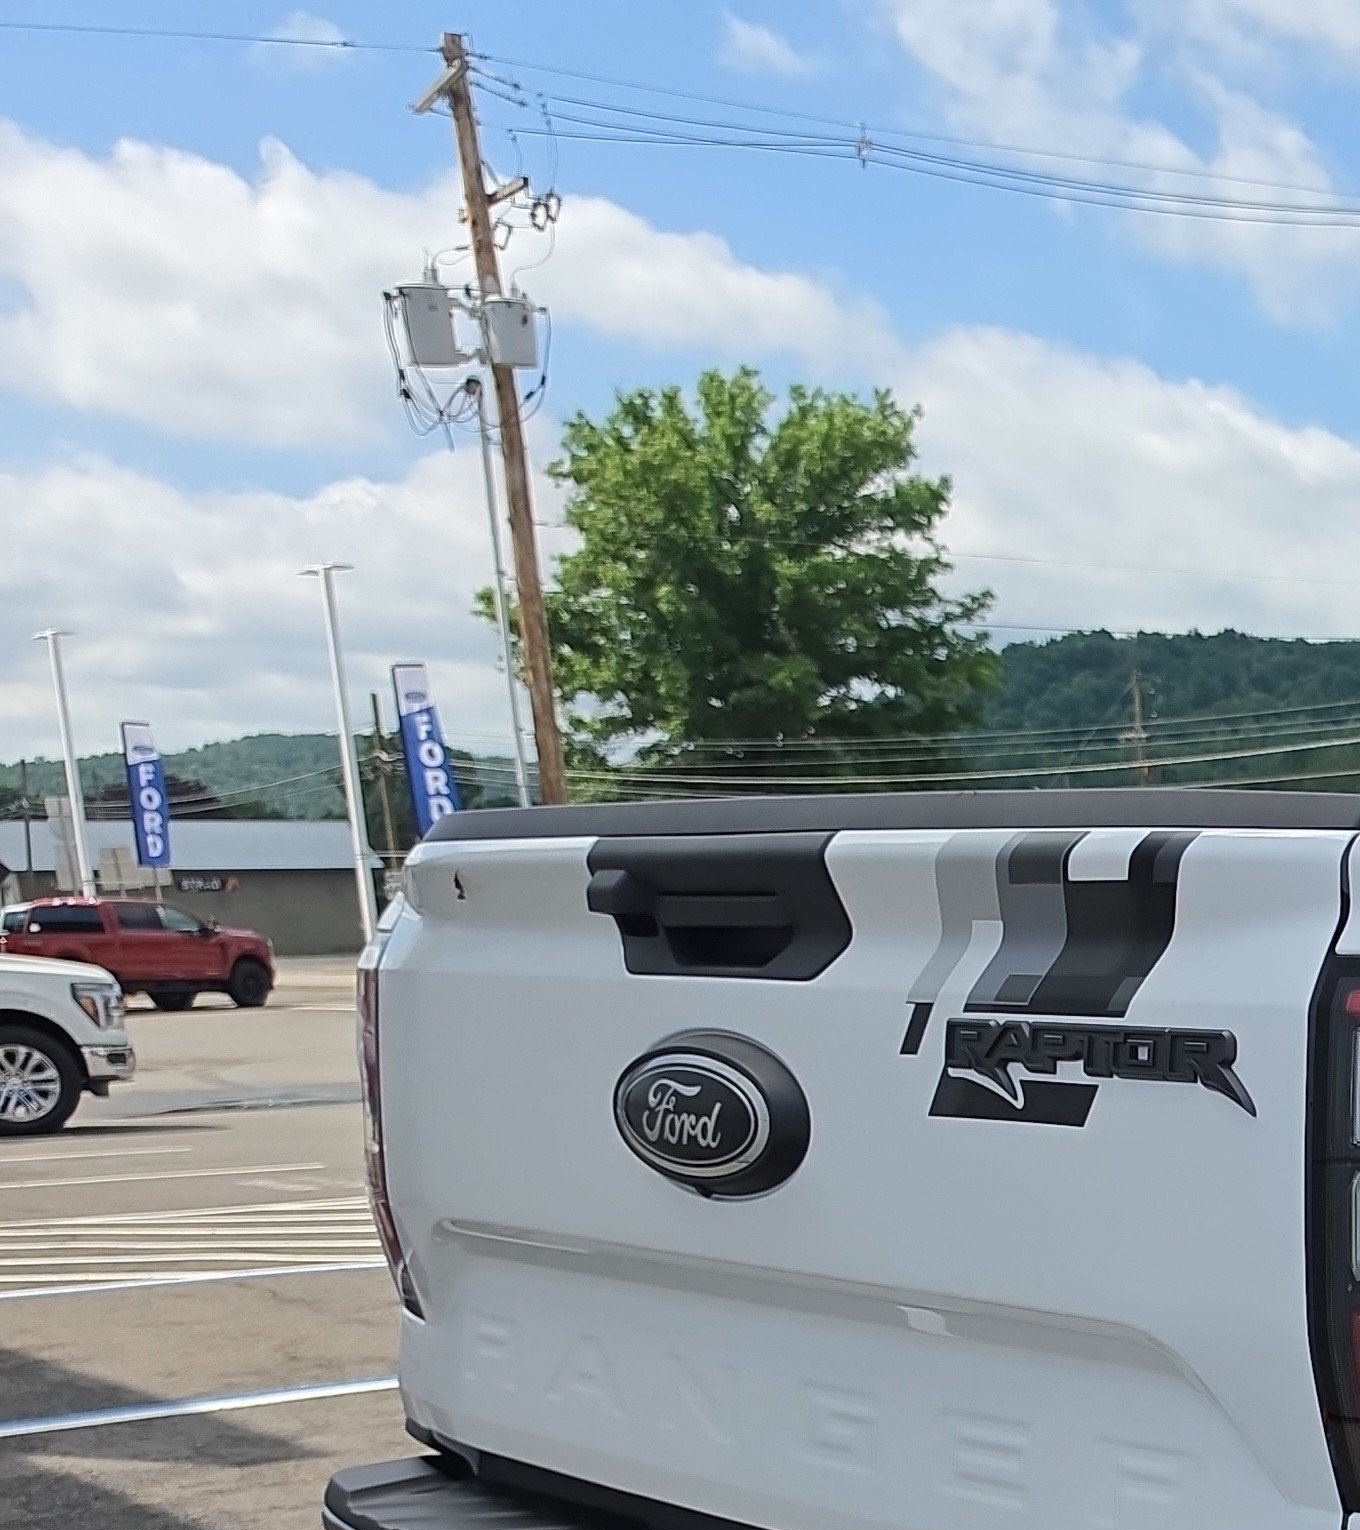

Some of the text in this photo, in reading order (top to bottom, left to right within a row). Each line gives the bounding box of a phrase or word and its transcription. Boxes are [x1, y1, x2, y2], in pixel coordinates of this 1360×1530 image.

[138, 762, 165, 859] FORD
[415, 711, 456, 824] FORD
[641, 1077, 722, 1150] Ford
[946, 1016, 1257, 1118] RAPTOR
